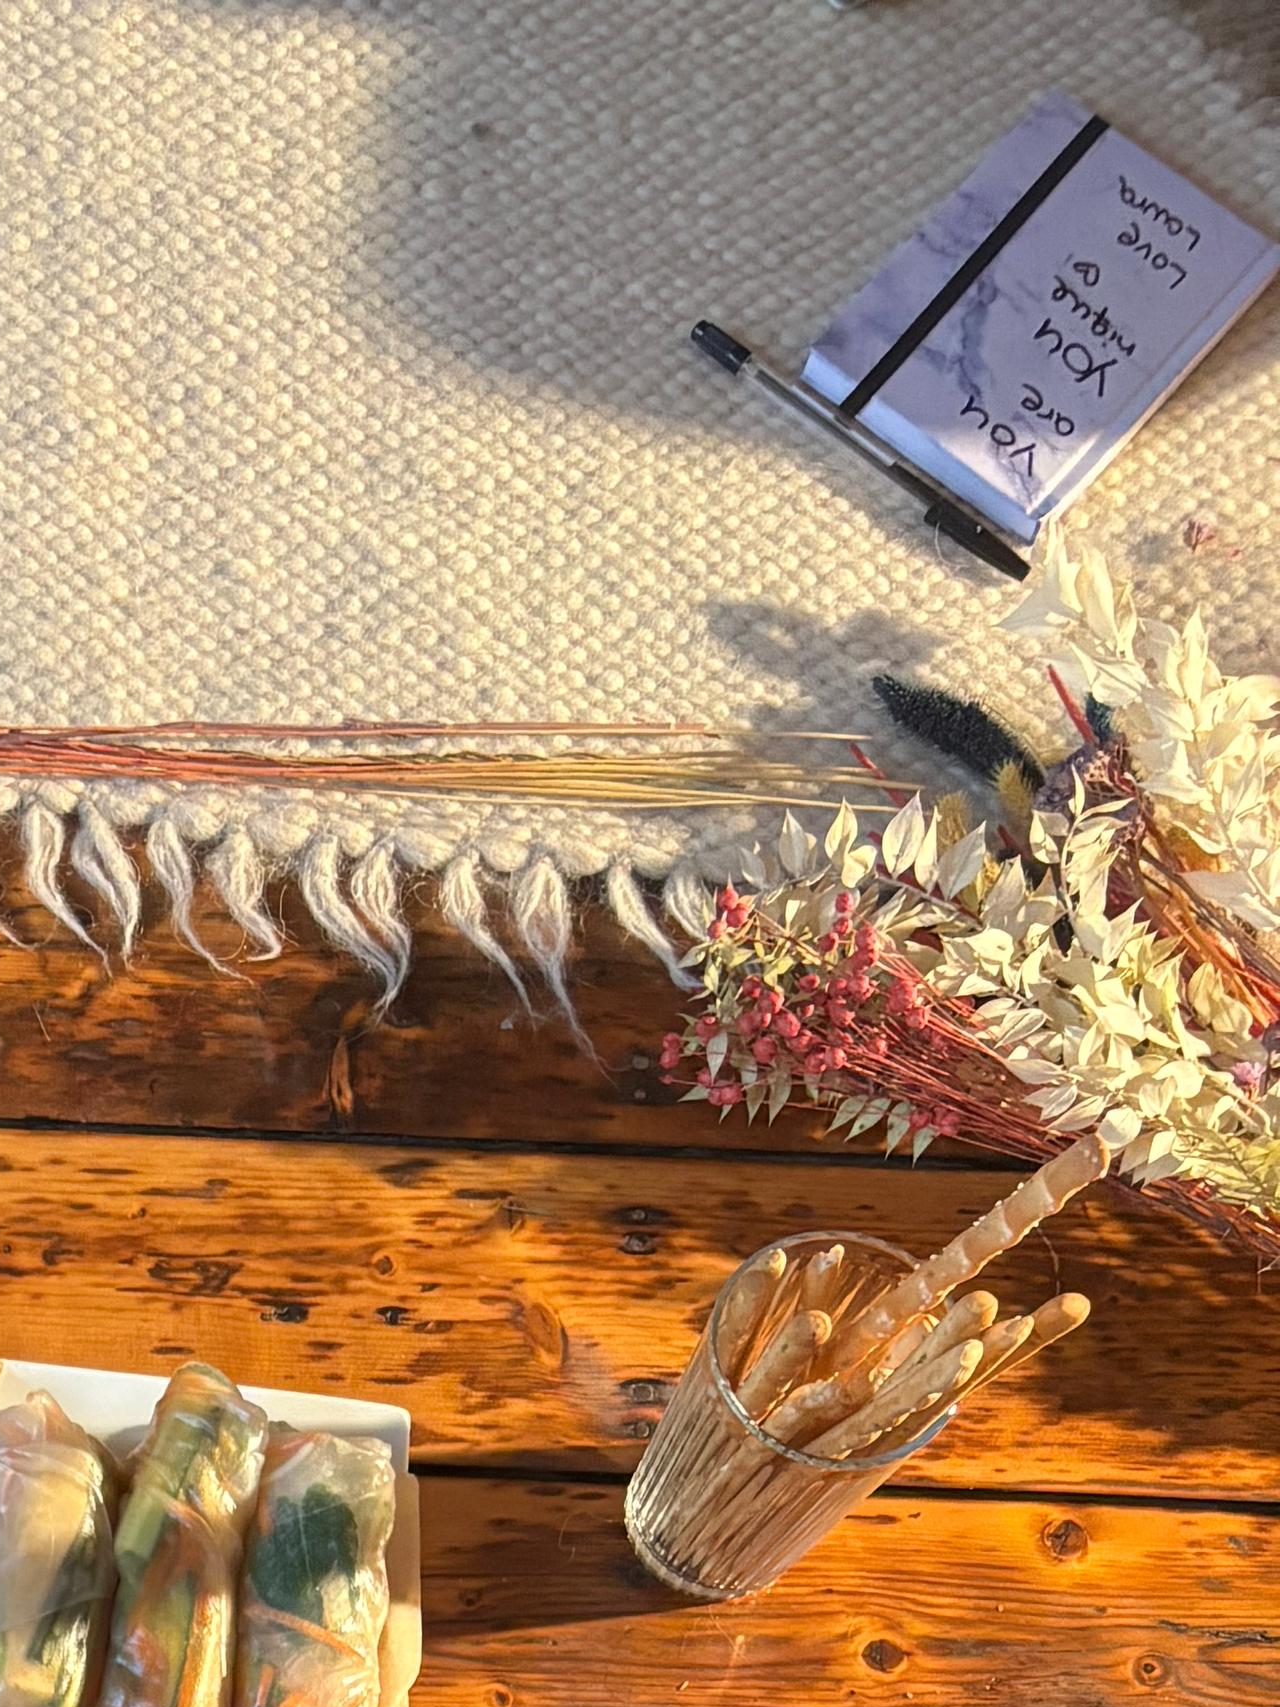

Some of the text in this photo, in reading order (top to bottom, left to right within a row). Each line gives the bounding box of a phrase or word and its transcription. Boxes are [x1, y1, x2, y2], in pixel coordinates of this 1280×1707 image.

[1118, 175, 1201, 252] Laura
[1117, 222, 1187, 290] Love
[1051, 276, 1136, 357] nique
[1021, 383, 1075, 437] are
